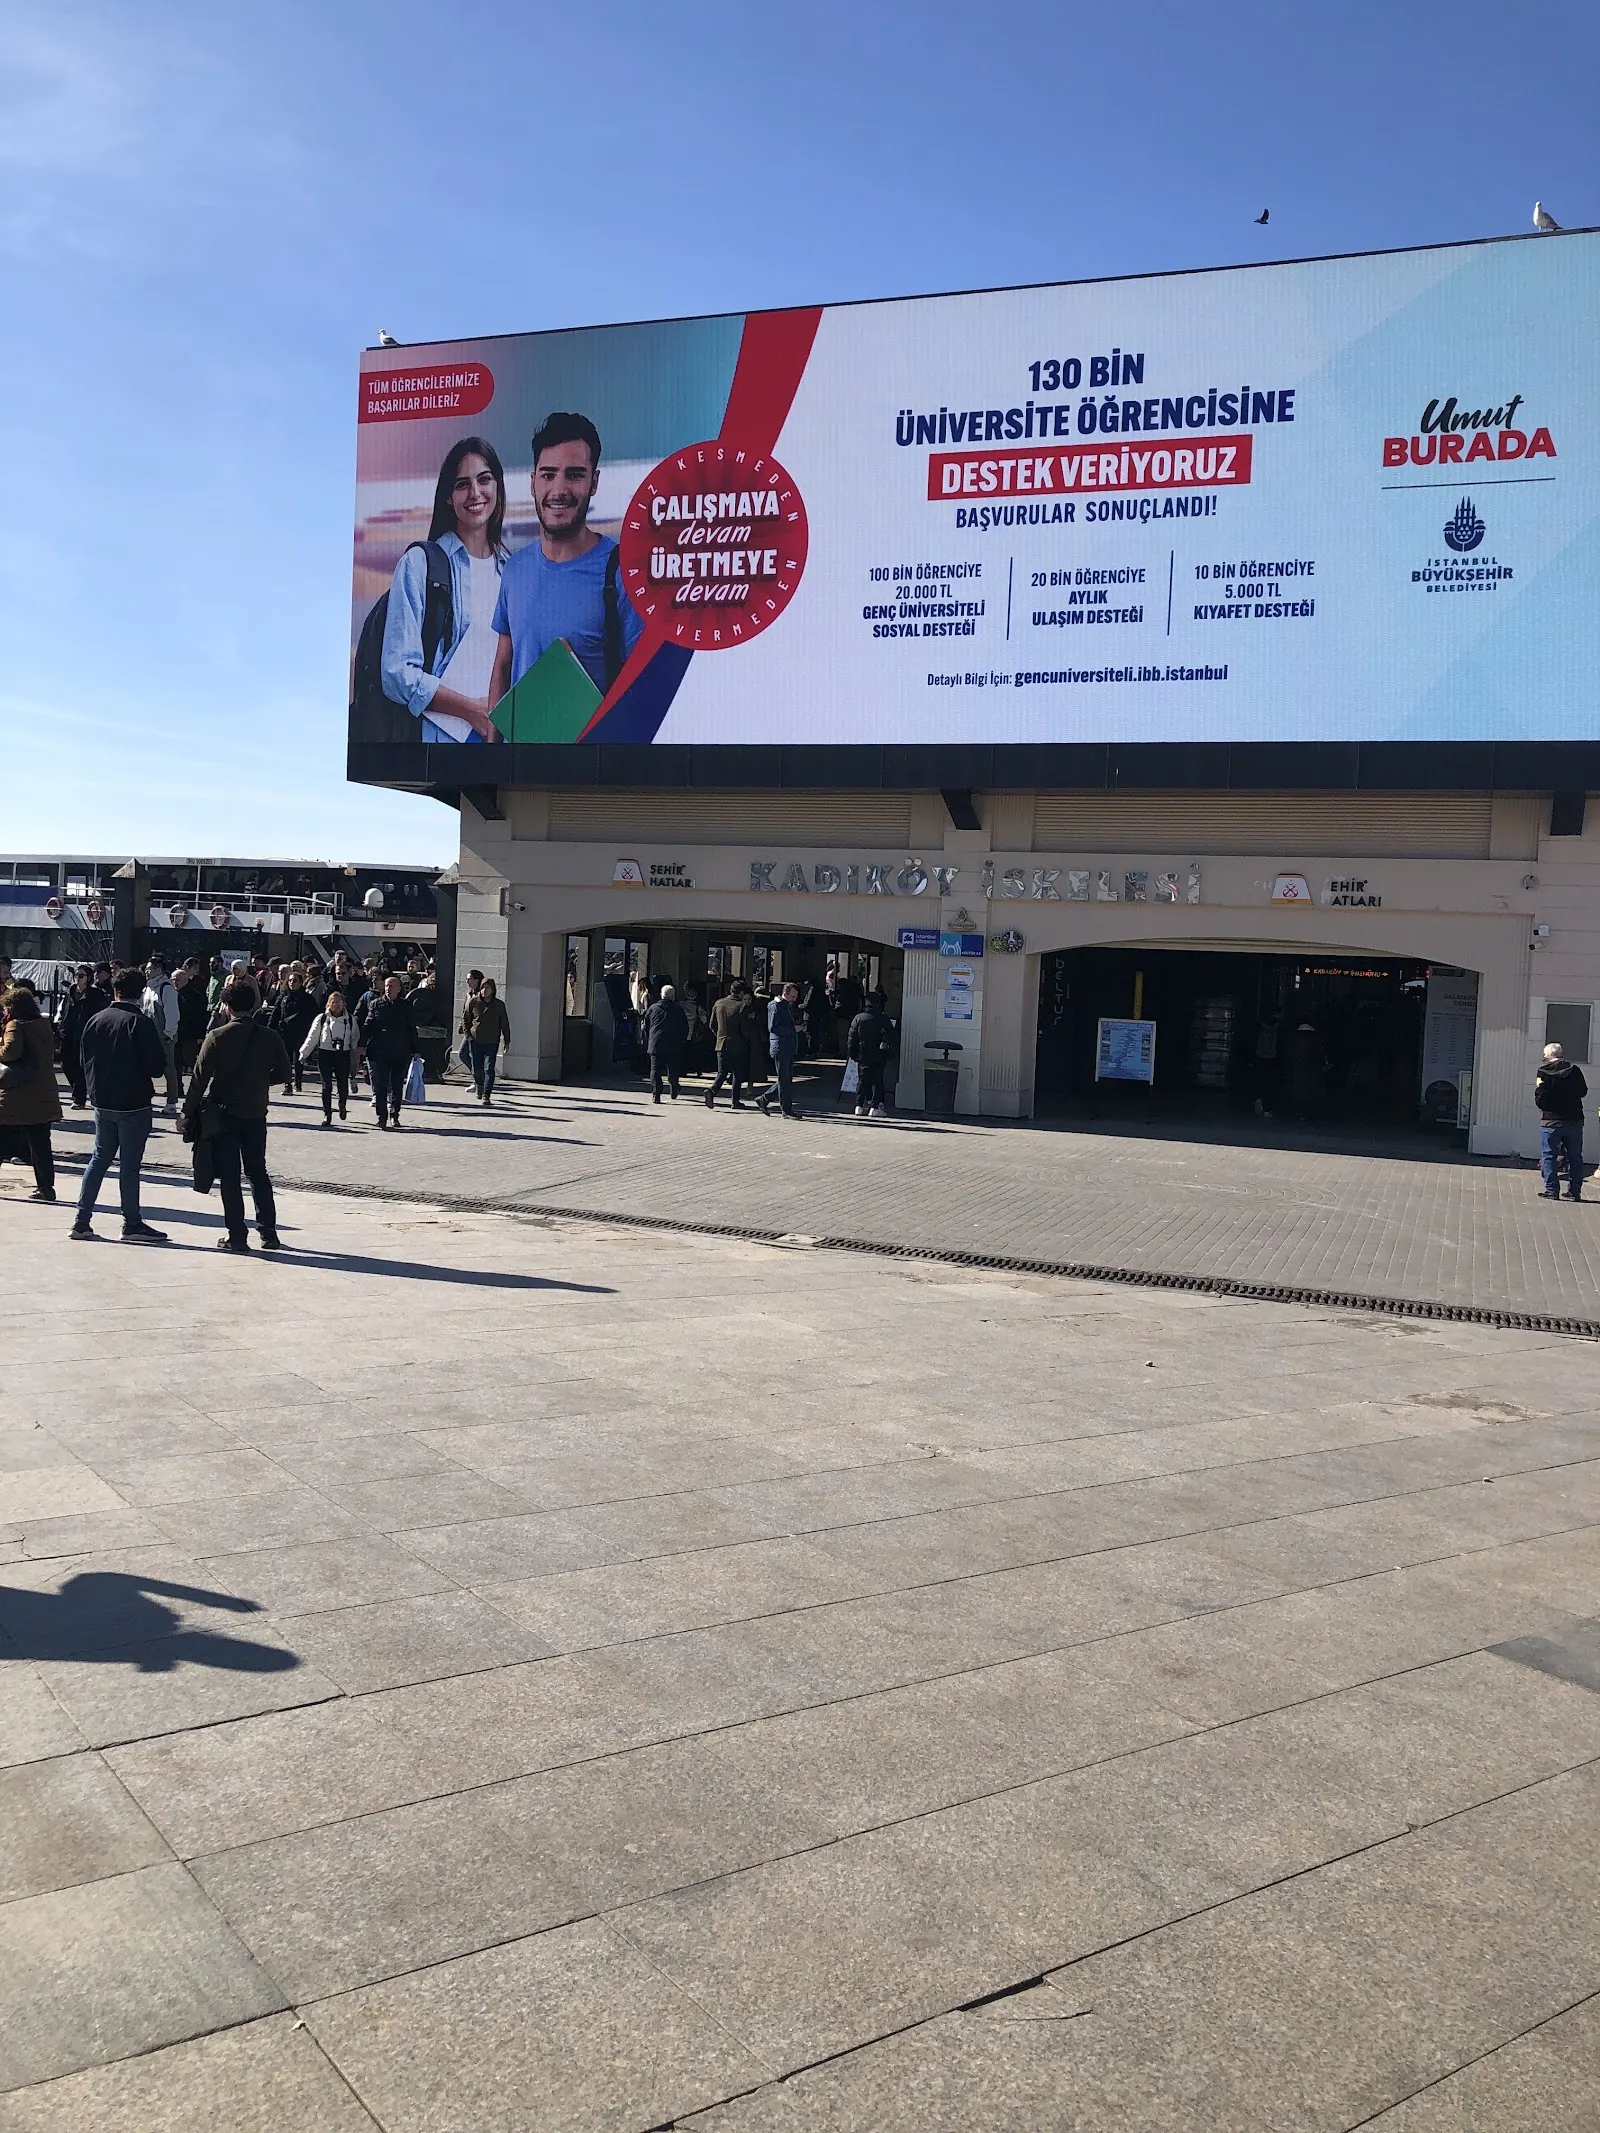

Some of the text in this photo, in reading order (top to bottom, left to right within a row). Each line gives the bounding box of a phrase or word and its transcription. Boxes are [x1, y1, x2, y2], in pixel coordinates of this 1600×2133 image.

[1028, 347, 1145, 392] 130 BİN
[368, 371, 480, 395] TÜM ÖĞRENCİLERİMİZE
[367, 391, 460, 416] BAŞARILAR DİLERİZ
[1420, 394, 1524, 434] Umut
[895, 385, 1296, 447] ÜNİVERSİTE ÖĞRENCİSİNE
[1382, 427, 1558, 467] BURADA
[941, 445, 1237, 495] DESTEK VERİYORUZ
[629, 448, 799, 531] HIZ KESMEDEN
[651, 490, 780, 526] ÇALIŞMAYA
[955, 495, 1217, 532] BAŞVURULAR SONUÇLANDI!
[677, 520, 752, 546] devam
[650, 546, 778, 579] ÜRETMEYE
[869, 561, 983, 582] 100 BİN ÖĞRENCİYE
[1194, 558, 1315, 580] 10 BİN ÖĞRENCİYE
[1411, 565, 1514, 582] BÜYÜKŞEHİR
[1427, 556, 1498, 567] İSTANBUL
[1031, 566, 1146, 587] 20 BİN ÖĞRENCİYE
[1426, 581, 1497, 593] BELEDİYESİ
[628, 559, 798, 642] ARA VERMEDEN
[675, 578, 750, 603] devam
[895, 583, 953, 600] 20.000 TL
[1068, 589, 1109, 605] AYLIK
[1225, 582, 1282, 599] 5.000 TL
[862, 599, 986, 622] GENÇ ÜNİVERSİTELİ
[1032, 605, 1144, 628] ULAŞIM DESTEĞİ
[1193, 599, 1315, 620] KIYAFET DESTEĞİ
[872, 618, 976, 638] SOSYAL DESTEĞİ
[927, 664, 1229, 689] Detaylı Bilgi İçin: gencuniversiteli.ibb.istanbul
[650, 862, 685, 876] ŞEHİR
[749, 857, 1201, 904] KADIKÖY İSKELESİ
